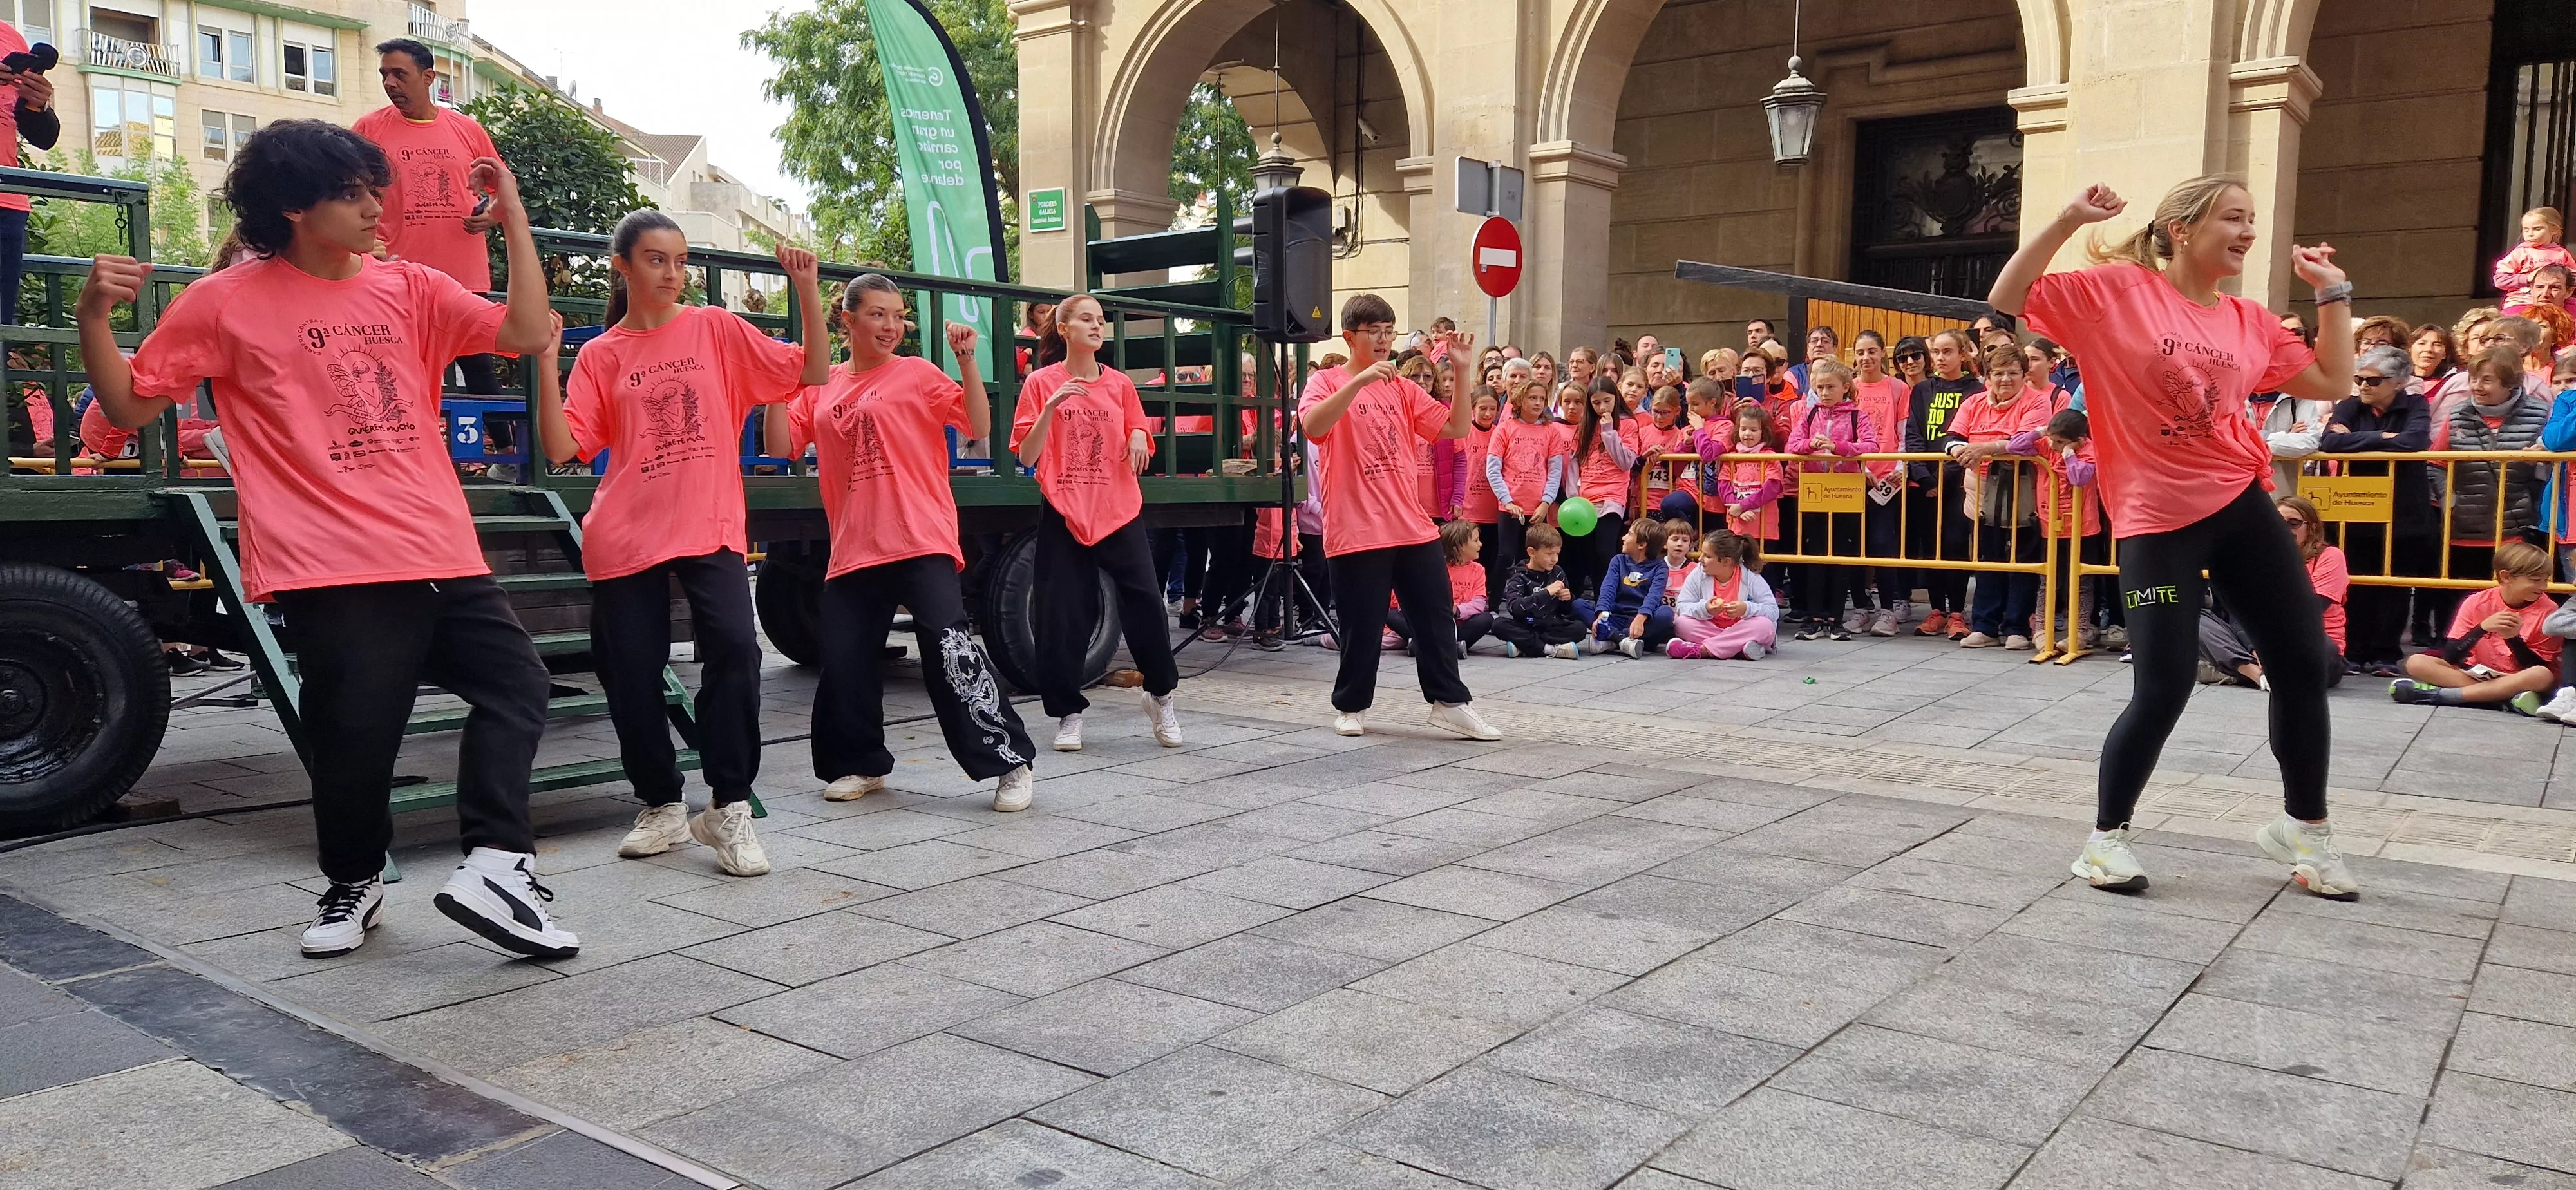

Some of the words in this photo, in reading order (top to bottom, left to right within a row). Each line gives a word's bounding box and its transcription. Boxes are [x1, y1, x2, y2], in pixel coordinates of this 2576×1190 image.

[307, 328, 330, 348] 9ª
[332, 323, 391, 336] CÁNCER
[364, 336, 404, 345] HUESCA
[2162, 338, 2182, 355] 9ª
[2184, 343, 2234, 362] CÁNCER
[630, 370, 646, 387] 9ª
[649, 357, 696, 374] CÁNCER
[674, 364, 705, 374] HUESCA
[2209, 358, 2241, 372] HUESCA
[1929, 392, 1963, 409] JUST
[833, 404, 847, 419] 9ª
[1064, 408, 1075, 421] 9ª
[1077, 408, 1109, 417] CÁNCER
[1927, 408, 1946, 425] DO
[386, 422, 415, 432] MUCHO
[457, 417, 478, 444] 3
[1926, 425, 1938, 441] IT
[1648, 470, 1669, 482] 143
